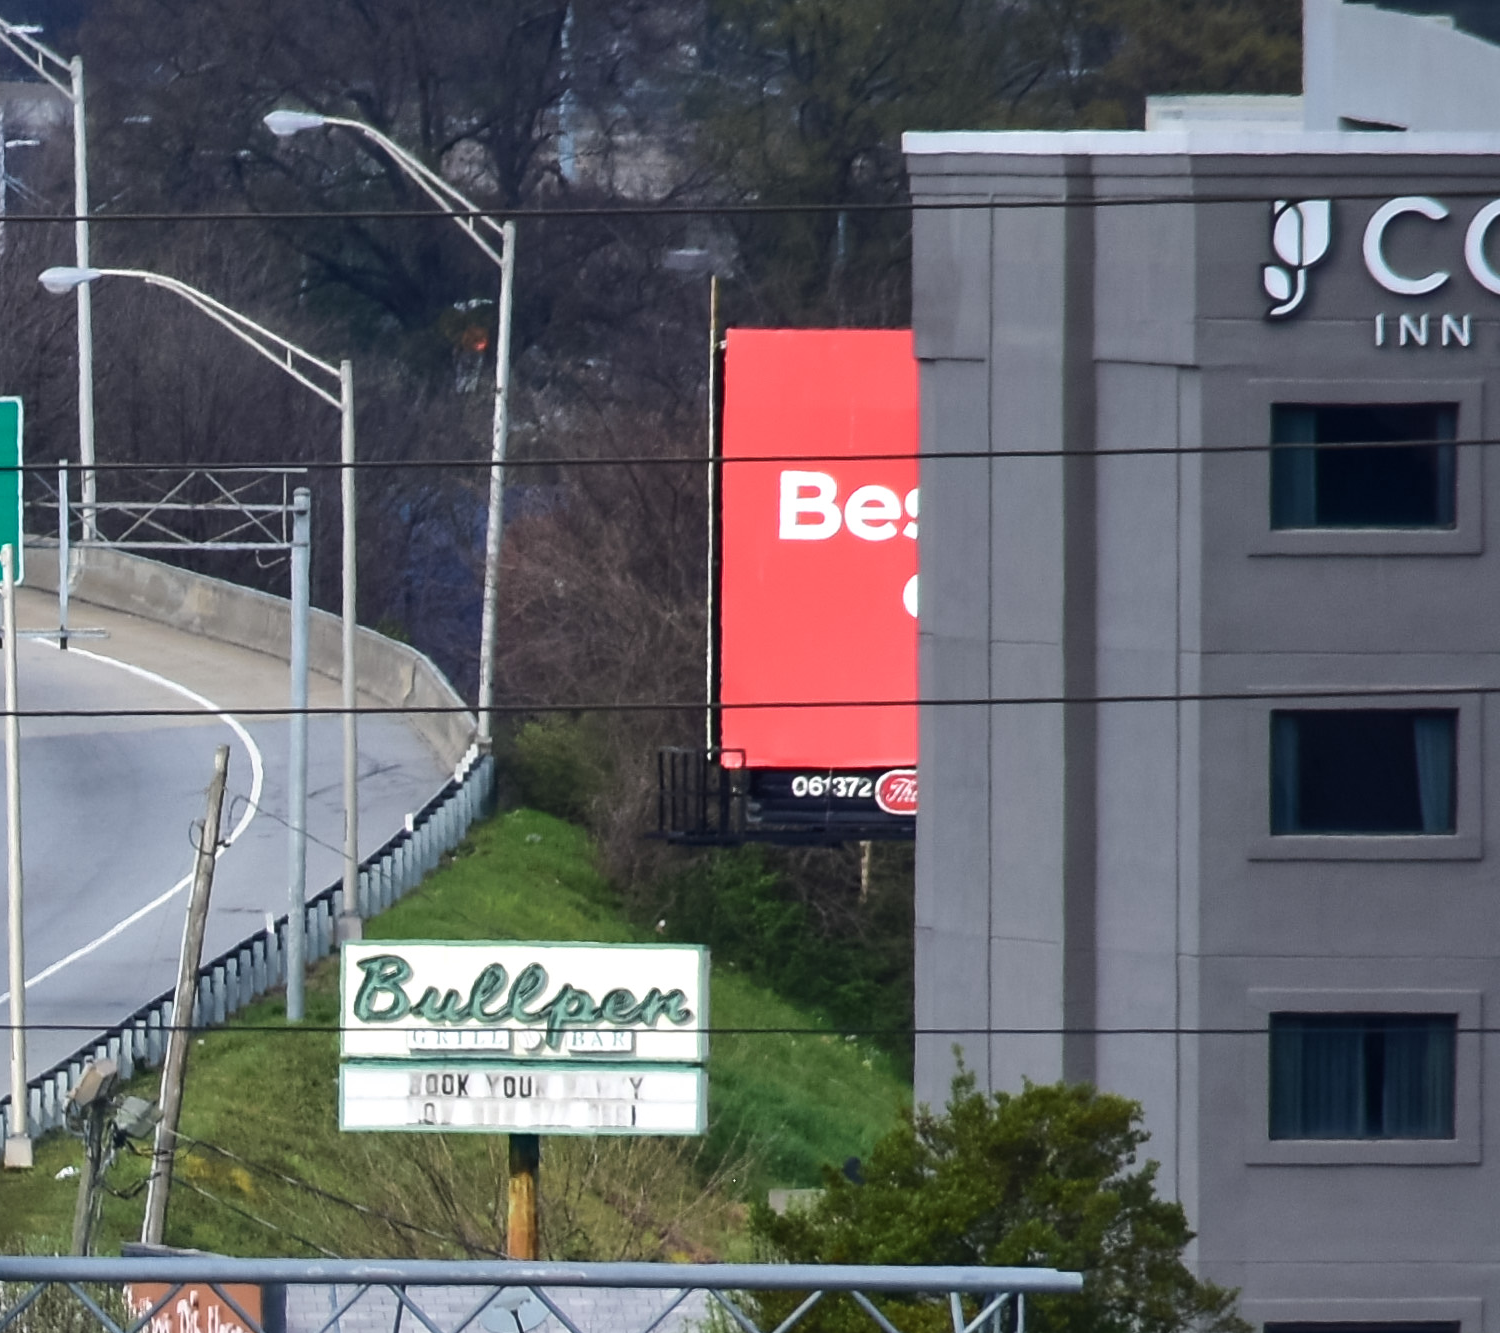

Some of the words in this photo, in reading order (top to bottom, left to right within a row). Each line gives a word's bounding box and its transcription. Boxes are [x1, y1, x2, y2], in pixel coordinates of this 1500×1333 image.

[1374, 313, 1473, 347] INN
[778, 469, 919, 542] Be
[352, 953, 696, 1050] Bullpen
[411, 1030, 506, 1046] GRILL
[571, 1030, 625, 1048] BAR
